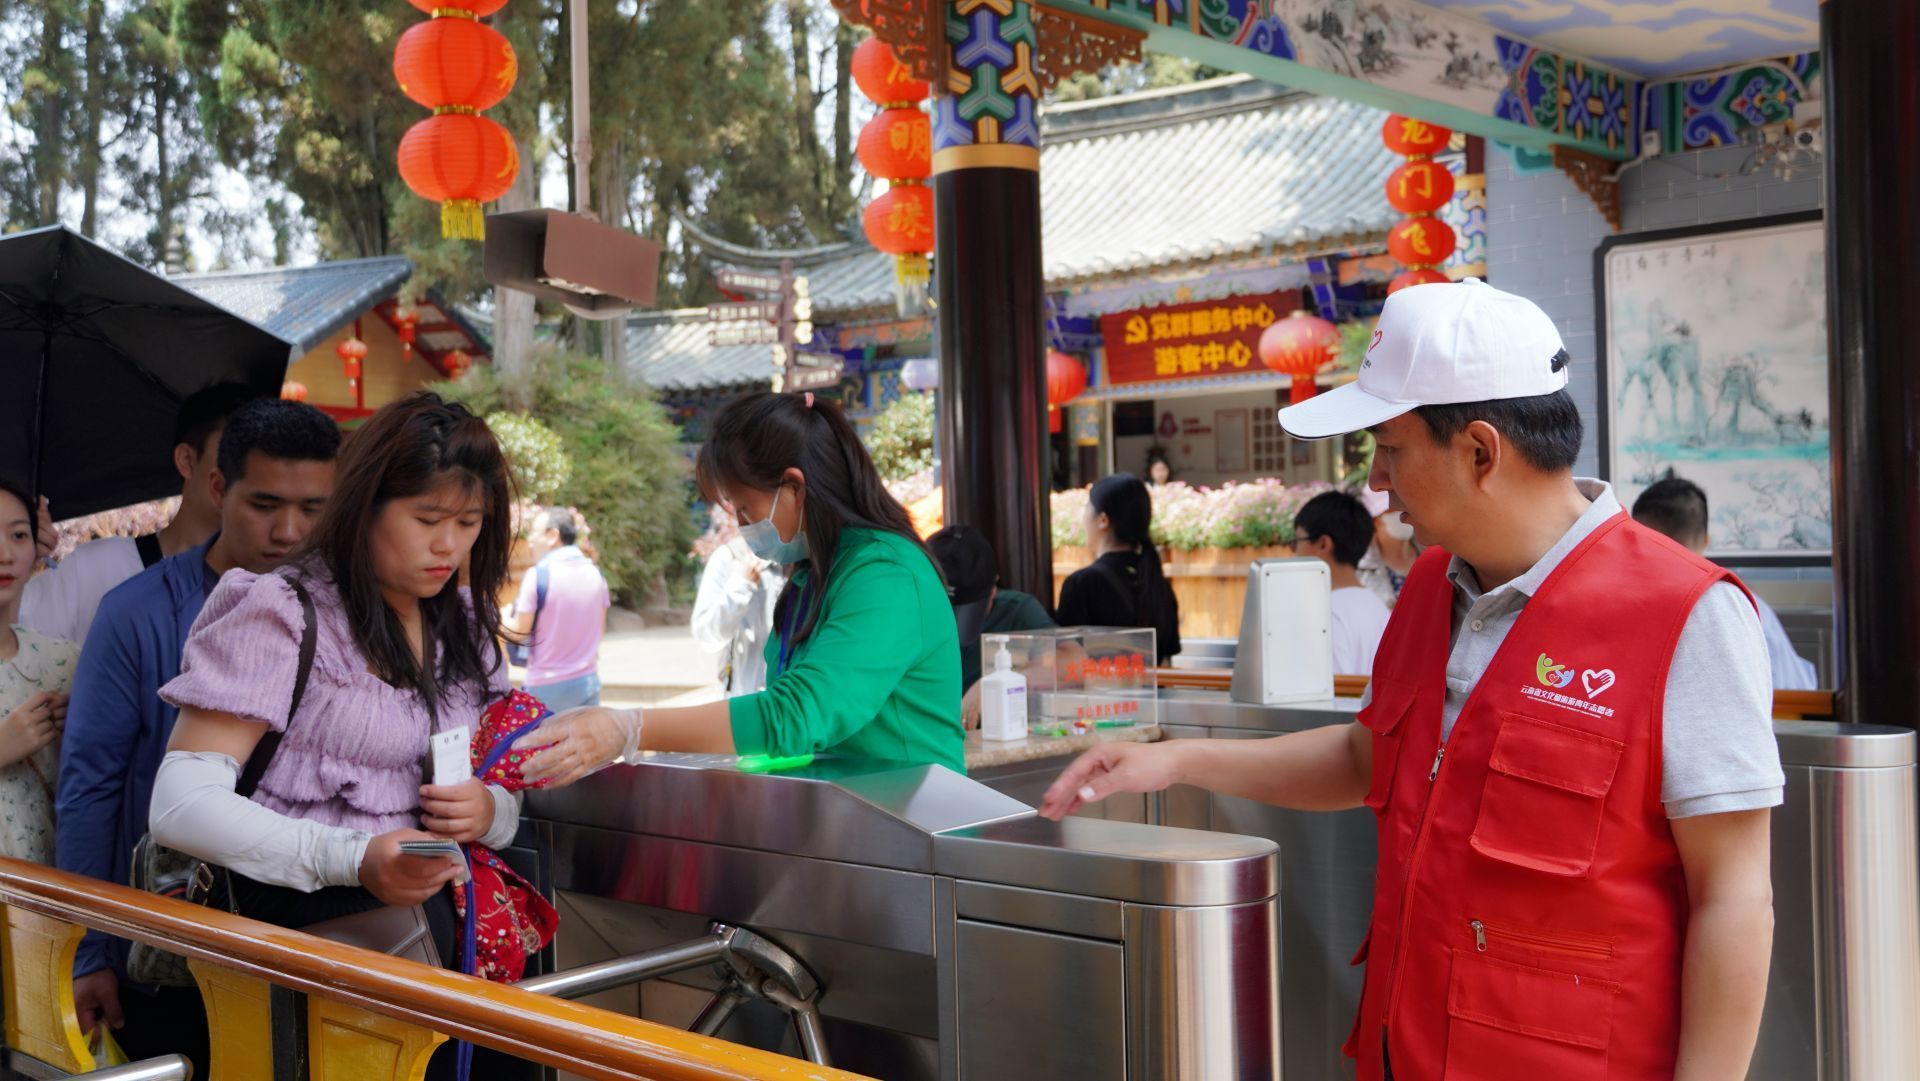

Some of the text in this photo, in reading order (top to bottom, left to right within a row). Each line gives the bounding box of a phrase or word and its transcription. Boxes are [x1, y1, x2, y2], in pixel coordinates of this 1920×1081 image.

[1150, 302, 1276, 341] 党群服务中心
[1154, 338, 1252, 376] 游客中心
